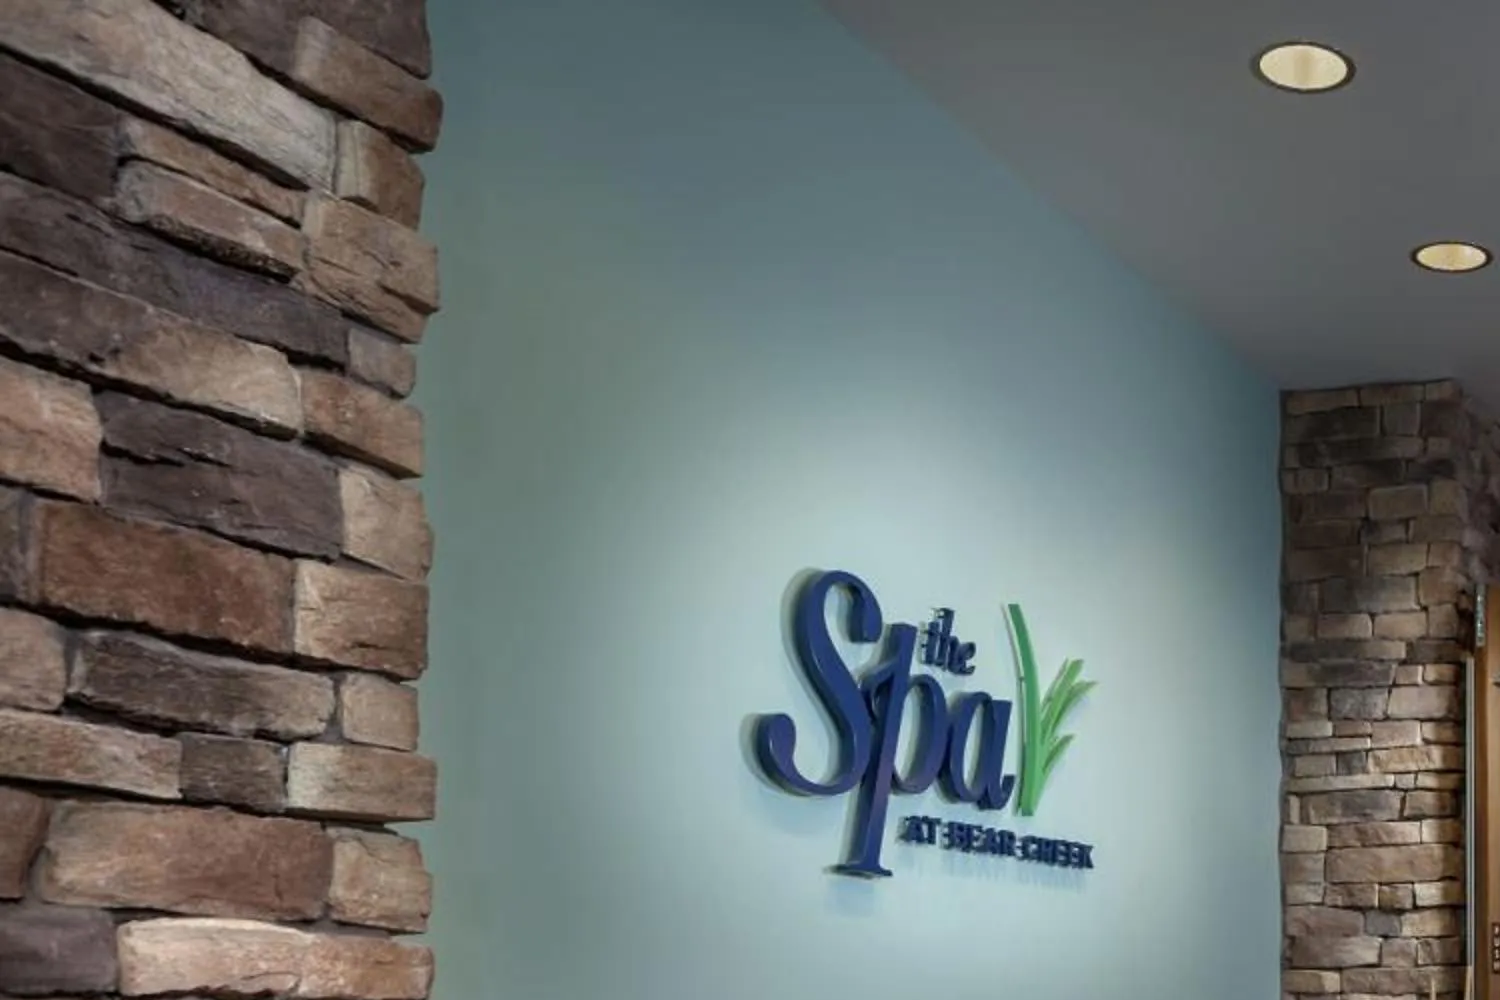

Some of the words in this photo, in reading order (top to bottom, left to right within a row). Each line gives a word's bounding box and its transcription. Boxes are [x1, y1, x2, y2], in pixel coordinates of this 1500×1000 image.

[921, 607, 976, 675] the
[754, 569, 1016, 878] Spa
[902, 815, 942, 846] AT
[945, 821, 1017, 857] BEAR
[1018, 834, 1095, 870] CREEK
